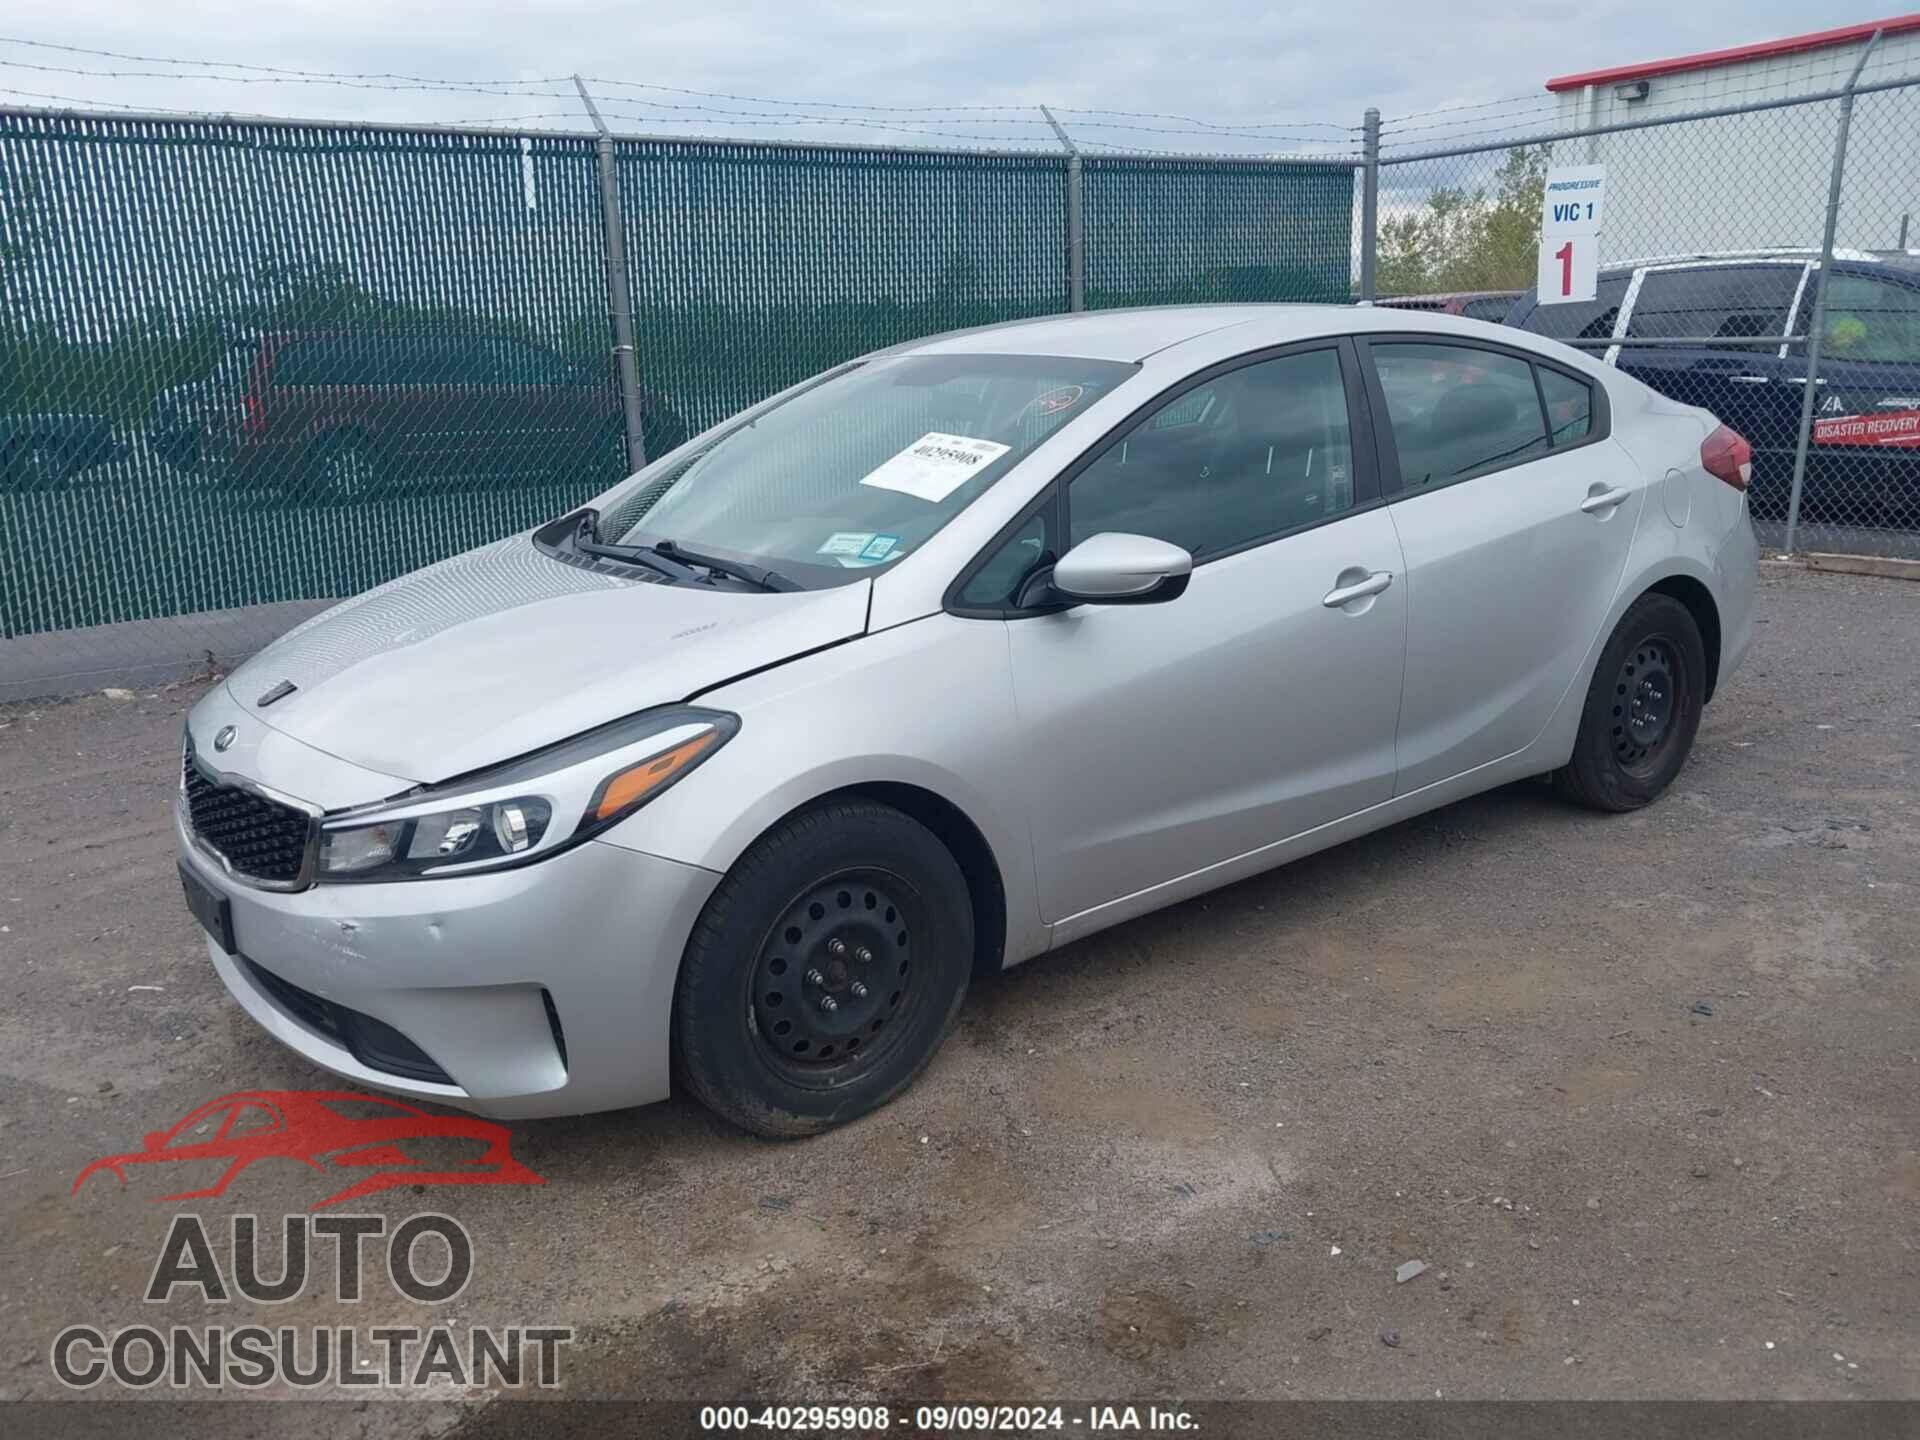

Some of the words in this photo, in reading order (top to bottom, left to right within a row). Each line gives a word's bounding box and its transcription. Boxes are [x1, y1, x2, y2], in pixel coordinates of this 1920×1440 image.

[1549, 180, 1601, 191] PROGRESSIVE
[1554, 203, 1580, 221] VIC
[1586, 202, 1593, 220] 1
[1555, 241, 1573, 296] 1
[1817, 422, 1865, 438] DISASTER
[1868, 416, 1919, 433] RECOVERY
